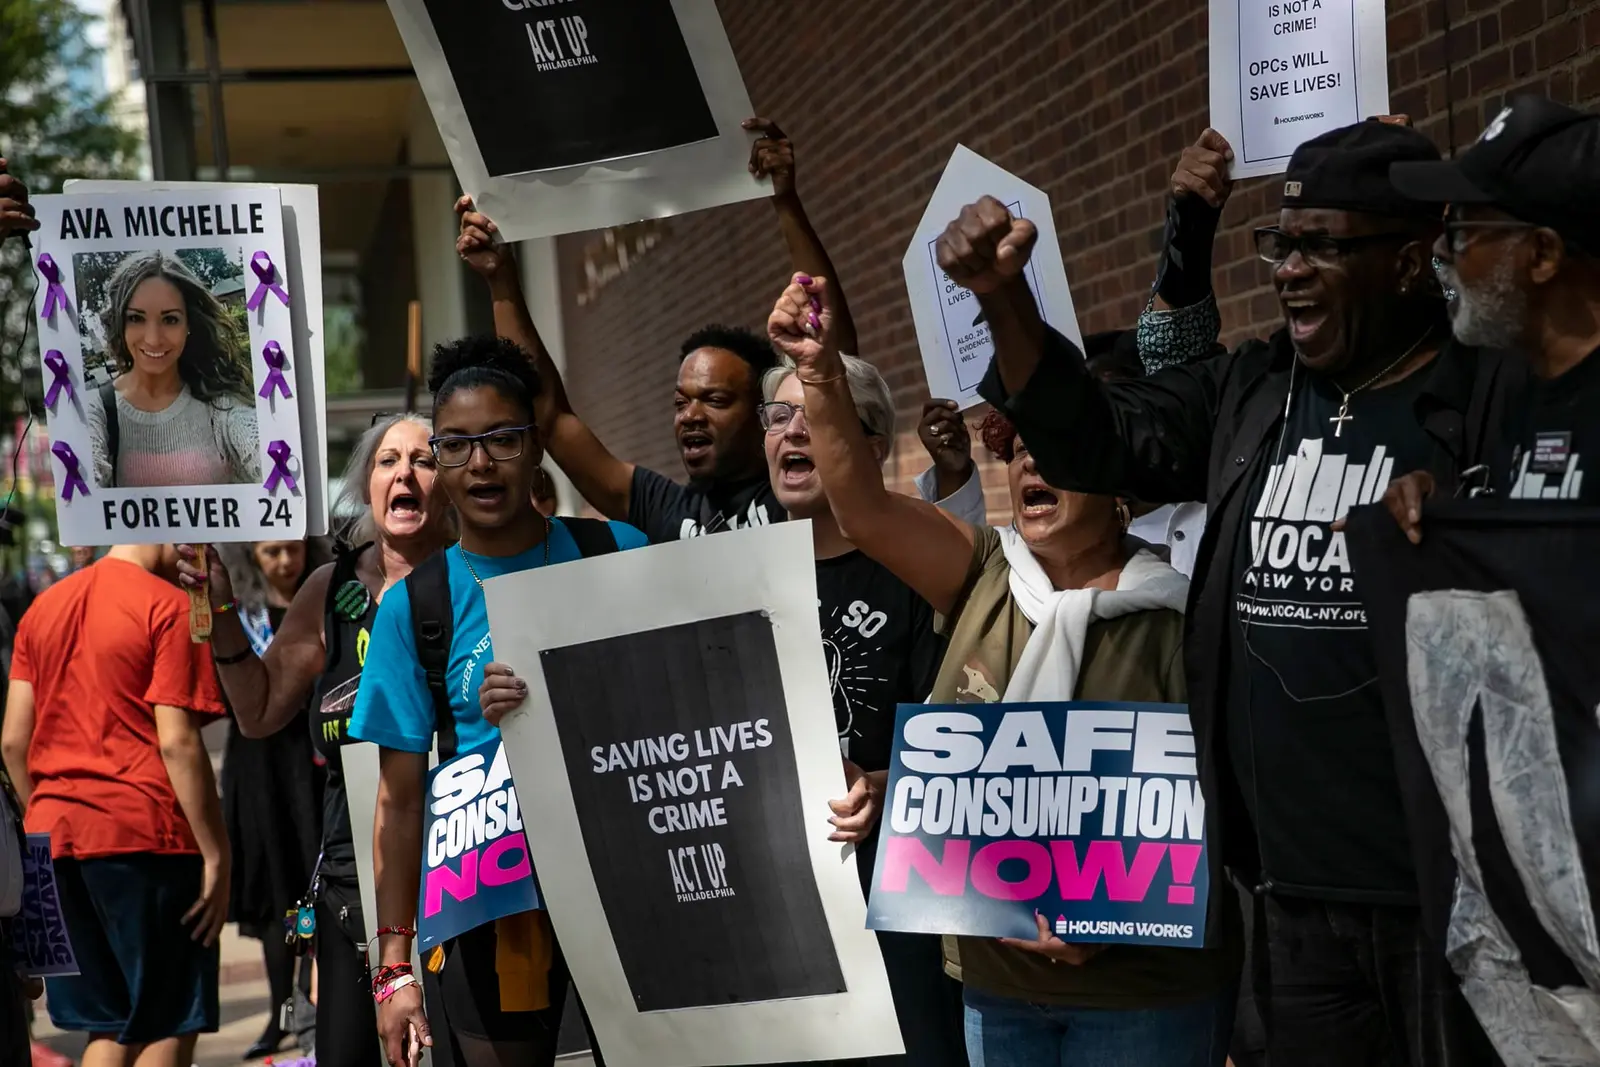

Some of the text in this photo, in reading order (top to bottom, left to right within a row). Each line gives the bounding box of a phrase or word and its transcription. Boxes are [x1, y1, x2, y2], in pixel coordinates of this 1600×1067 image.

[1268, 0, 1322, 18] IS NOT A
[1273, 16, 1317, 36] CRIME!
[525, 15, 590, 64] ACT UP
[536, 55, 599, 72] PHILADELPHIA
[1249, 50, 1329, 77] OPCs WILL
[1250, 73, 1341, 101] SAVE LIVES!
[1280, 112, 1325, 124] HOUSING WORKS
[60, 203, 265, 240] AVA MICHELLE
[958, 336, 990, 355] EVIDENCE
[103, 498, 293, 530] FOREVER 24
[1251, 521, 1352, 573] VOCA
[1245, 571, 1355, 592] NEW YOR
[841, 600, 888, 639] SO
[462, 658, 476, 702] PEER
[322, 718, 340, 742] IN
[590, 718, 773, 774] SAVING LIVES
[900, 710, 1199, 776] SAFE
[430, 740, 513, 817] SA
[628, 760, 745, 803] IS NOT A
[648, 798, 728, 835] CRIME
[890, 775, 1207, 841] CONSUMPTION
[424, 832, 532, 919] NO
[668, 842, 729, 895] ACT UP
[880, 836, 1204, 905] NOW!
[36, 843, 74, 967] SAVING
[677, 887, 736, 904] PHILADELPHIA
[1068, 920, 1193, 938] HOUSING WORKS
